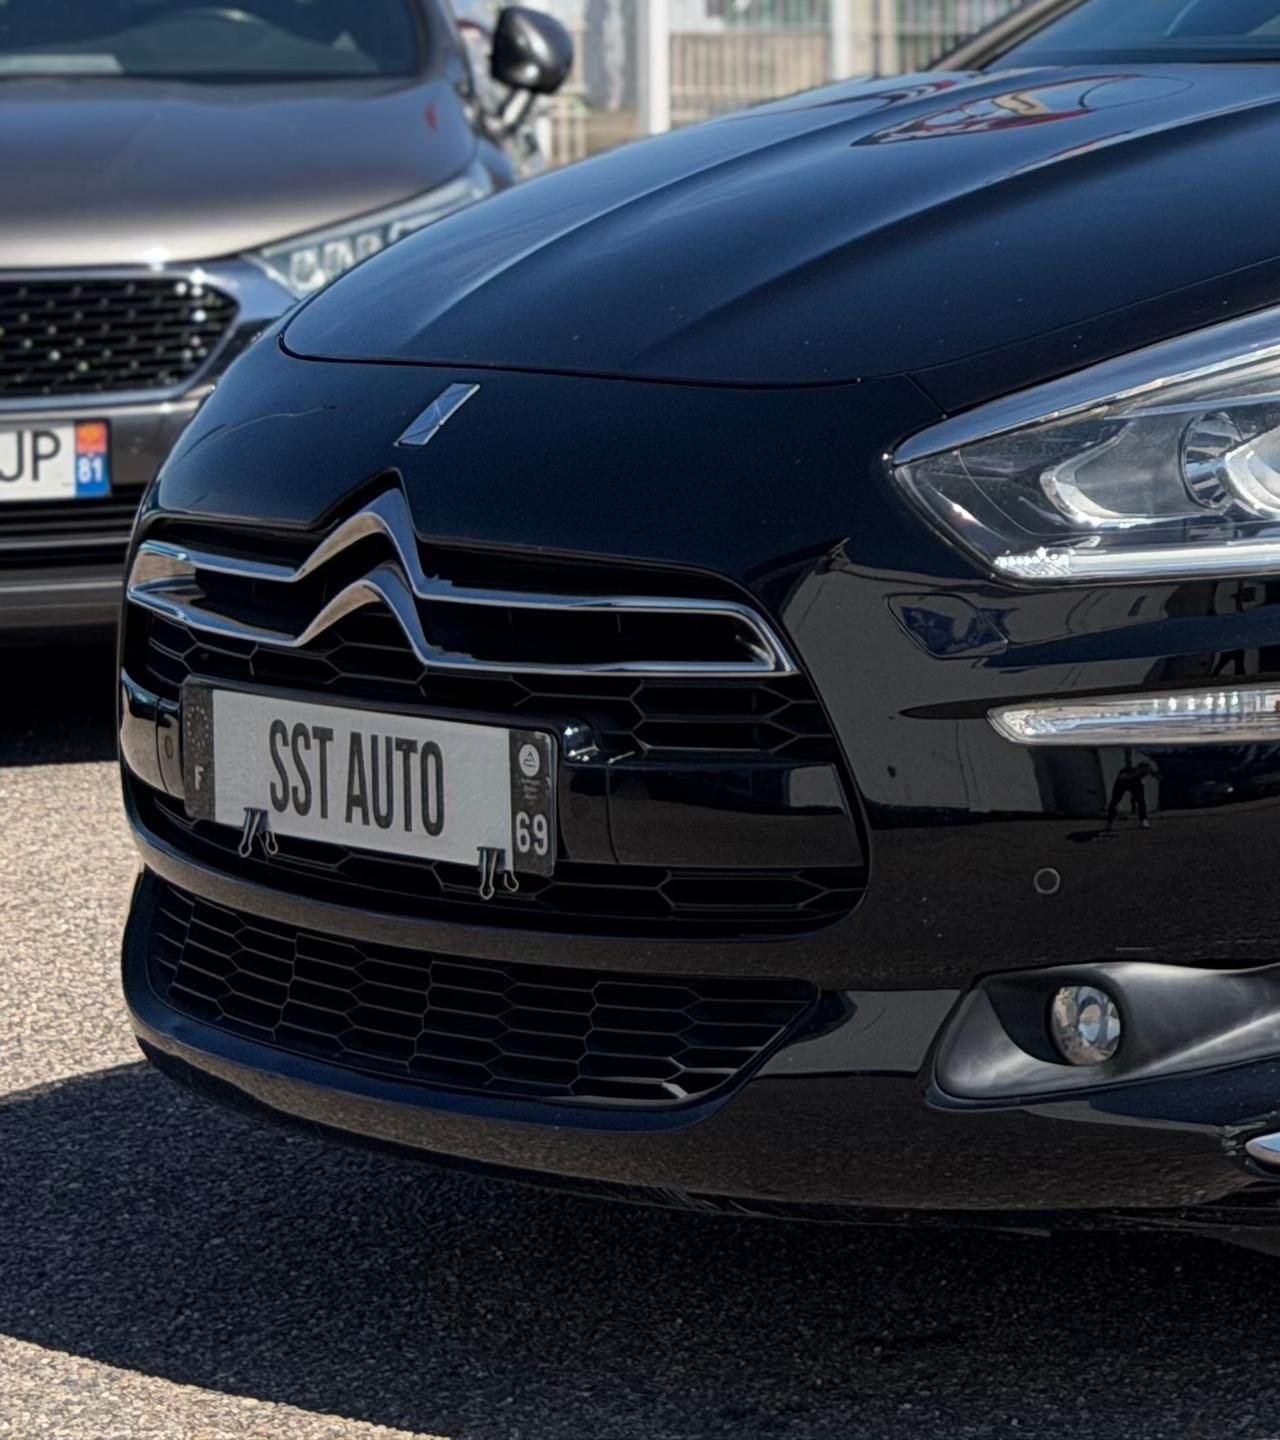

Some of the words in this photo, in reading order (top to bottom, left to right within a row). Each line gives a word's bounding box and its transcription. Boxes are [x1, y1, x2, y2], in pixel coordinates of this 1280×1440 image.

[78, 456, 102, 483] 81
[194, 764, 204, 790] F
[269, 719, 334, 820] SST
[345, 731, 445, 837] AUTO
[516, 811, 548, 855] 69
